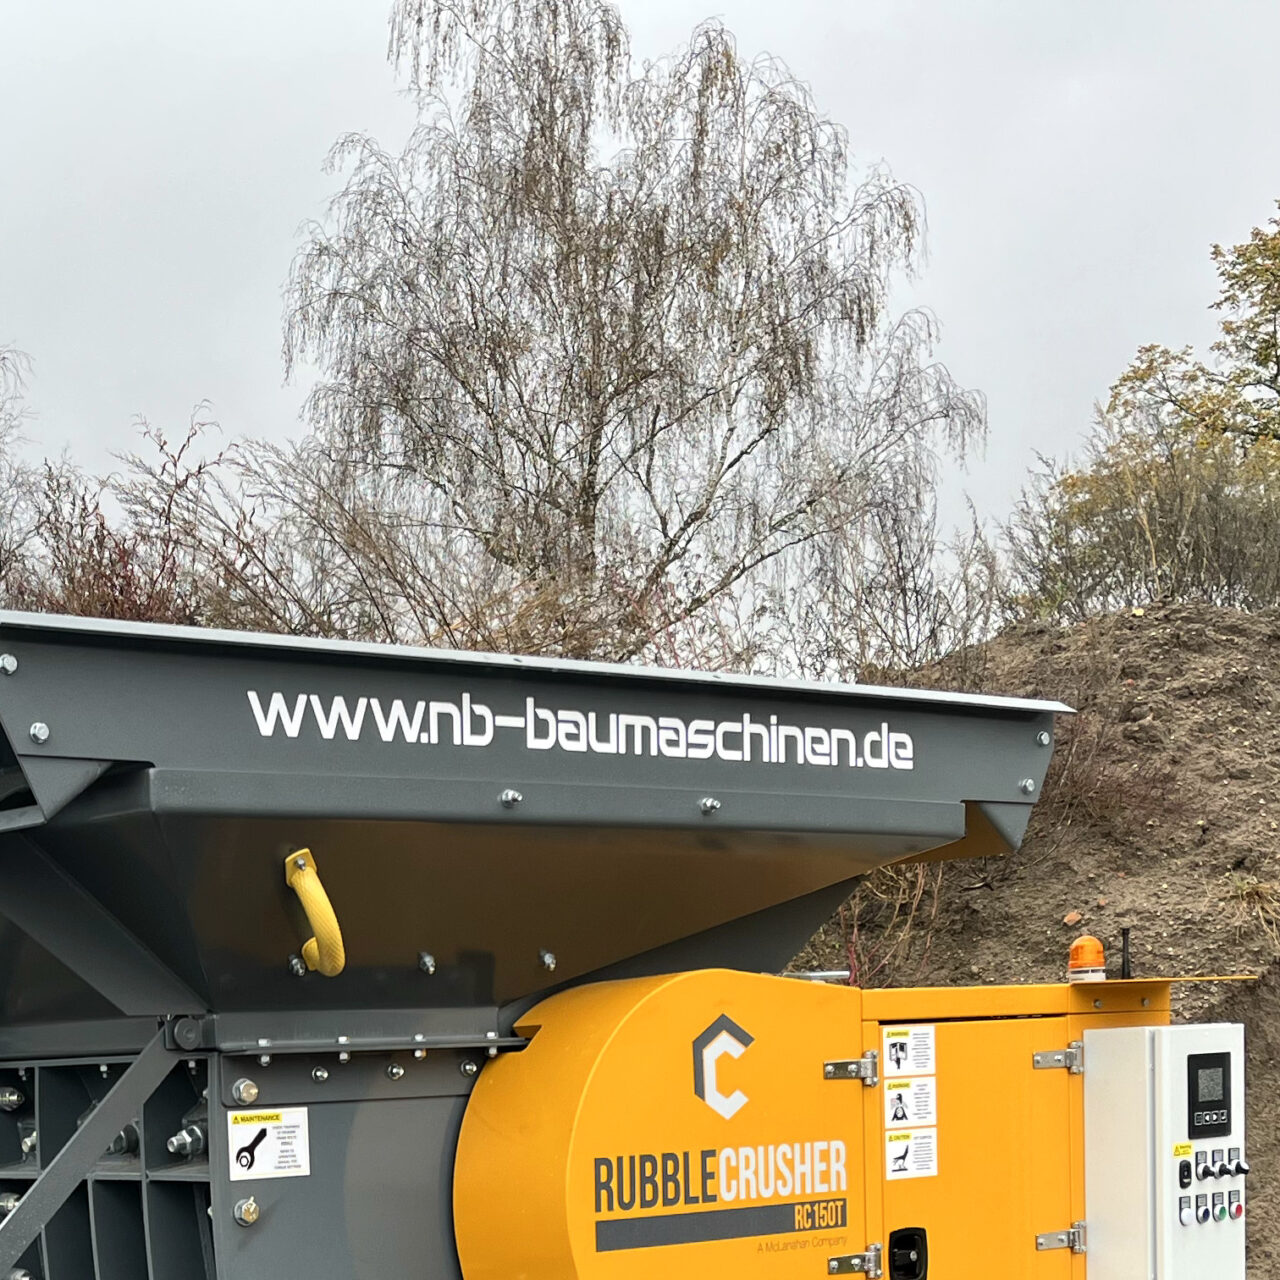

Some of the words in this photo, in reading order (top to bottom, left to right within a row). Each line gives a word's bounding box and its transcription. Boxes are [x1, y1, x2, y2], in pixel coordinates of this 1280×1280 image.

[247, 690, 913, 771] www.nb-baumaschinen.de
[240, 1114, 280, 1123] MAINTENANCE
[594, 1140, 847, 1213] RUBBLECRUSHER
[811, 1236, 848, 1249] Company
